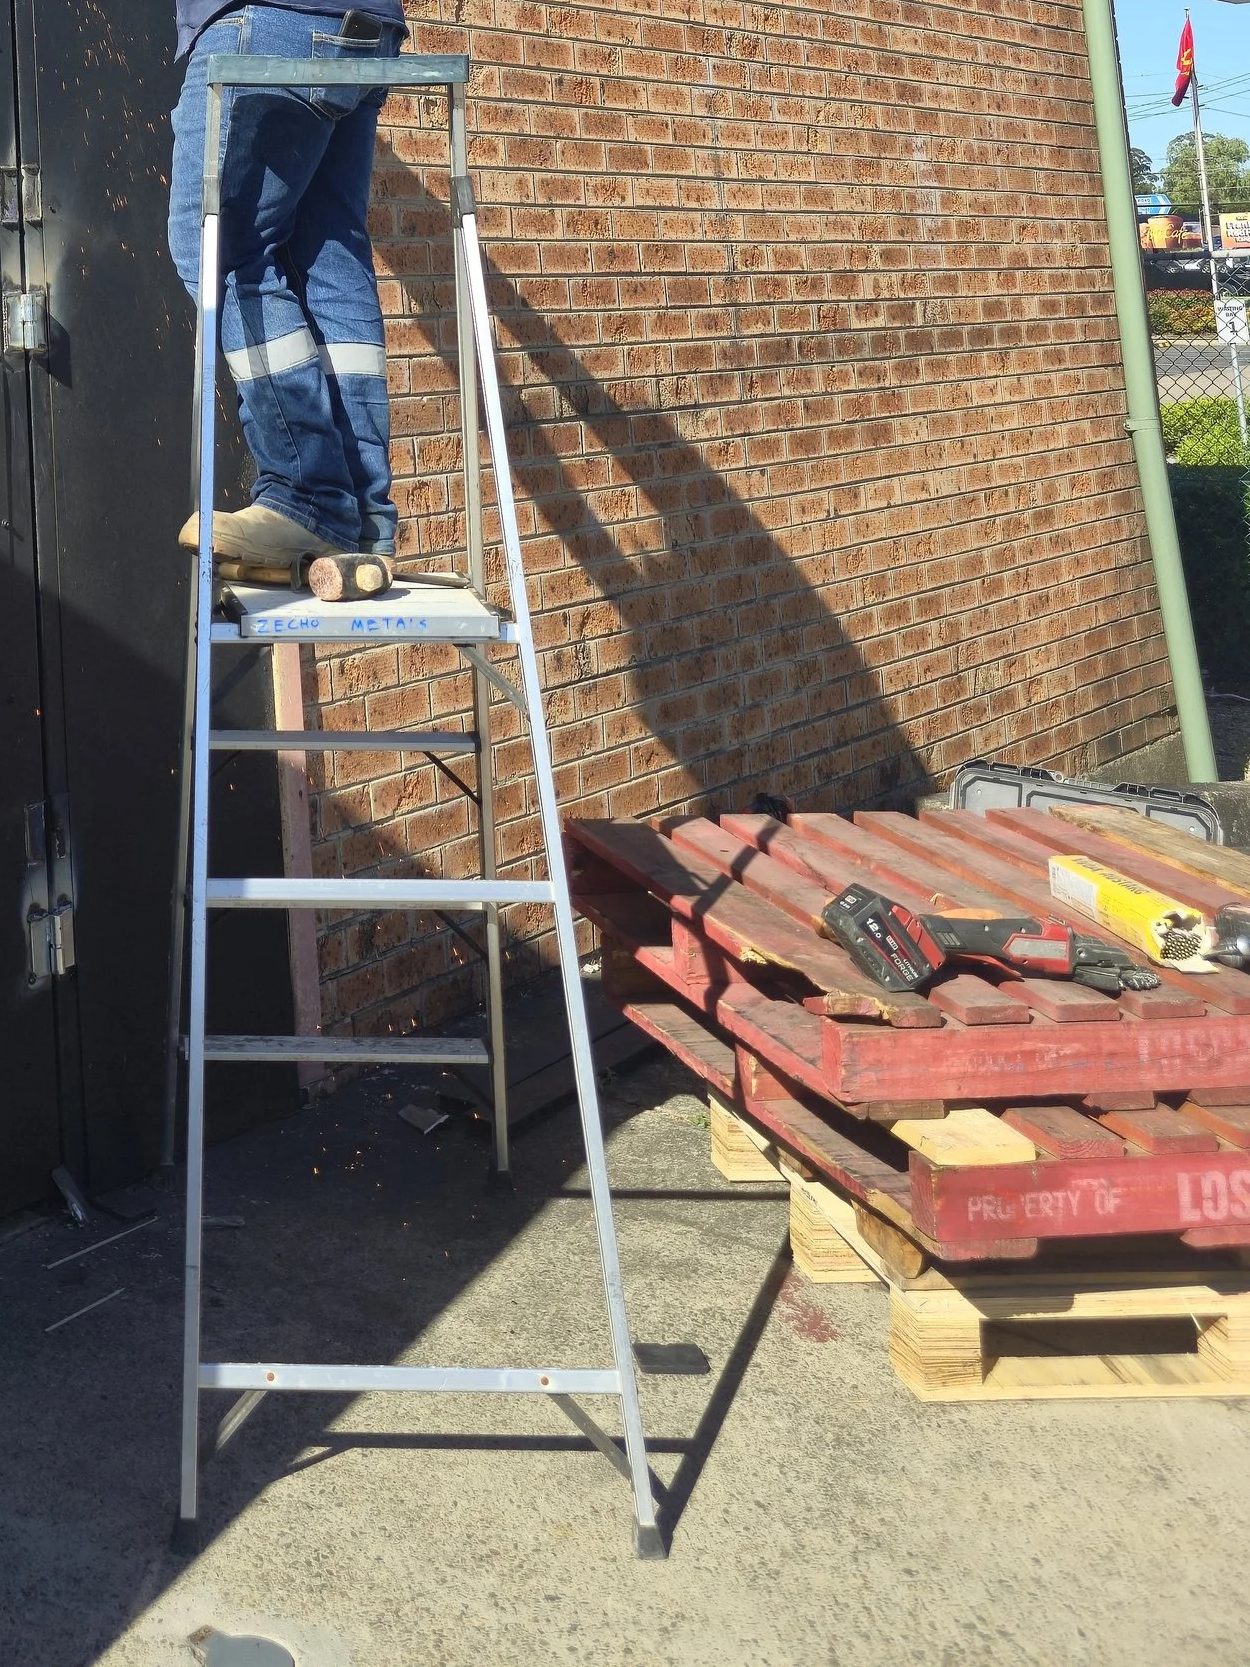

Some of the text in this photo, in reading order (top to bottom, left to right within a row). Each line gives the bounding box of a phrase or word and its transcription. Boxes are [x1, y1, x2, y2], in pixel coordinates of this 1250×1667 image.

[257, 617, 428, 633] ZECHO METAS
[890, 953, 914, 982] FORGE
[967, 1190, 1082, 1222] PROERTY
[1093, 1187, 1124, 1216] OF
